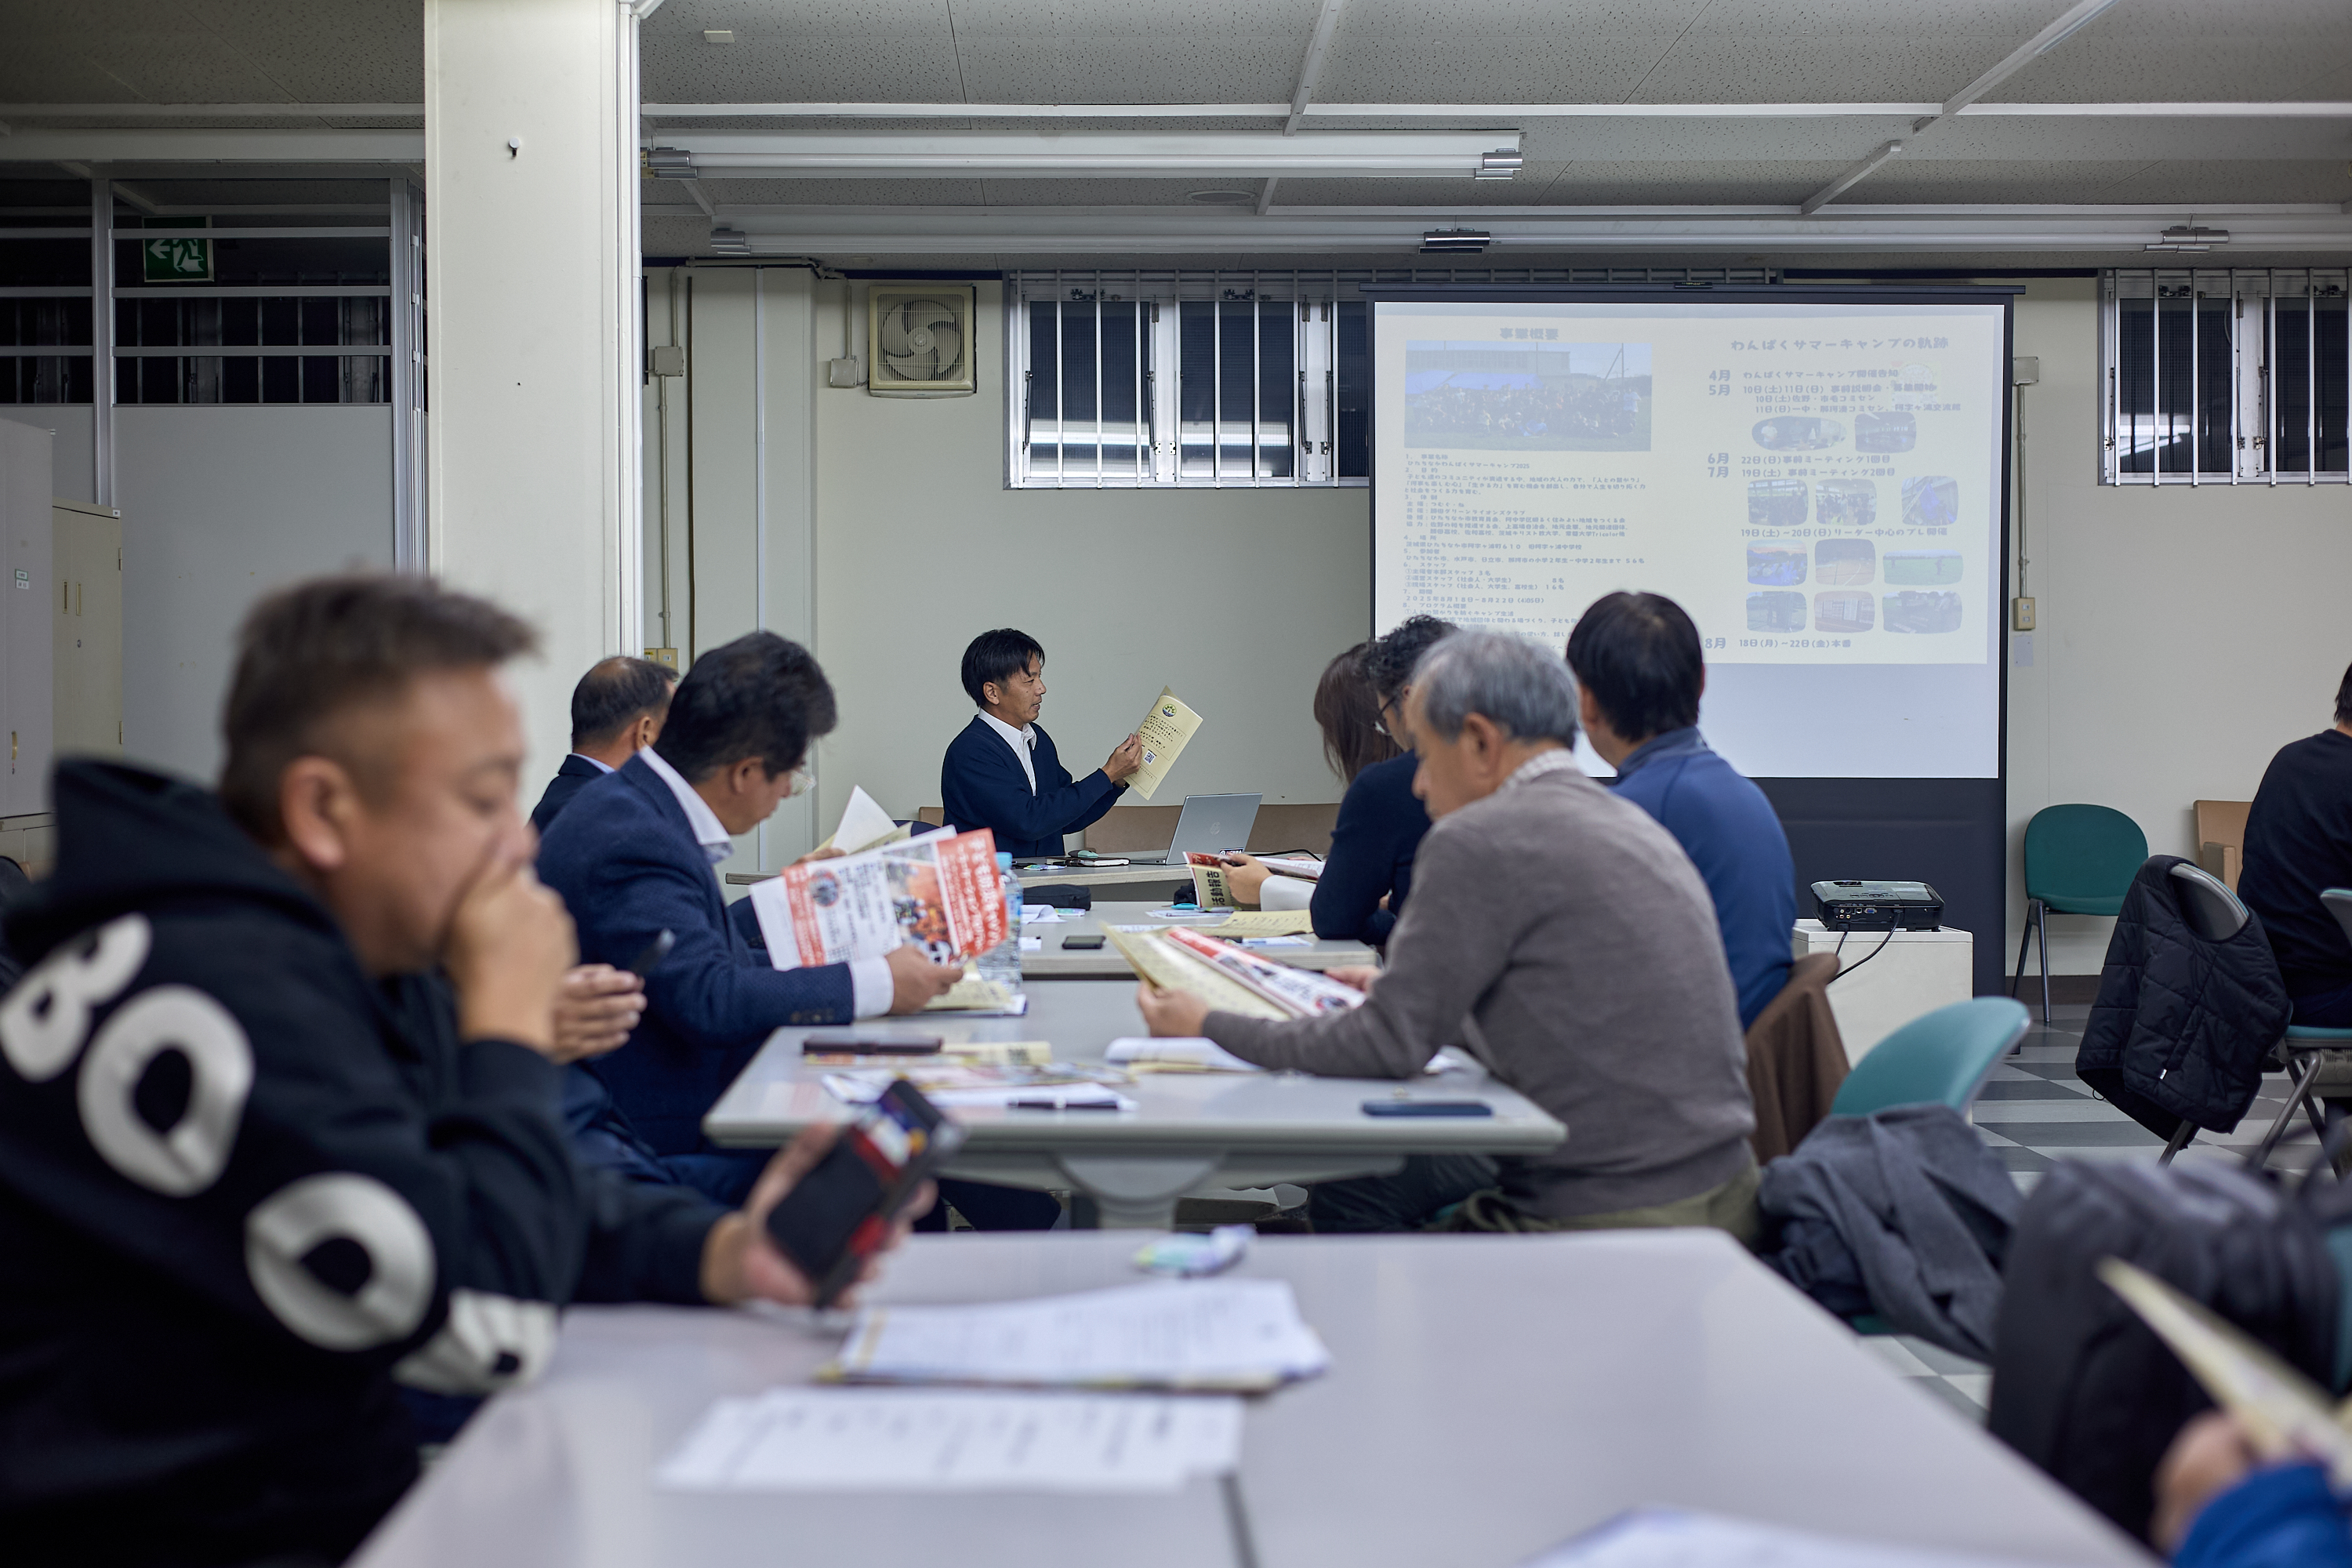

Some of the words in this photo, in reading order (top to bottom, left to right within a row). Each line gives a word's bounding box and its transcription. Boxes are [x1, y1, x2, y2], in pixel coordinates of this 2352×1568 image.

[1500, 327, 1559, 340] 事業概要
[1730, 336, 1949, 351] わんぱくサマーキャンプの軌跡
[1708, 369, 1731, 382] 4月
[1743, 368, 1898, 379] わんぱくサマーキャンプ開催告知
[1708, 384, 1731, 396] 5月
[1708, 452, 1730, 465] 6月
[1708, 466, 1730, 478] 7月
[1704, 637, 1726, 649] 8月
[1206, 870, 1225, 906] 活動報告
